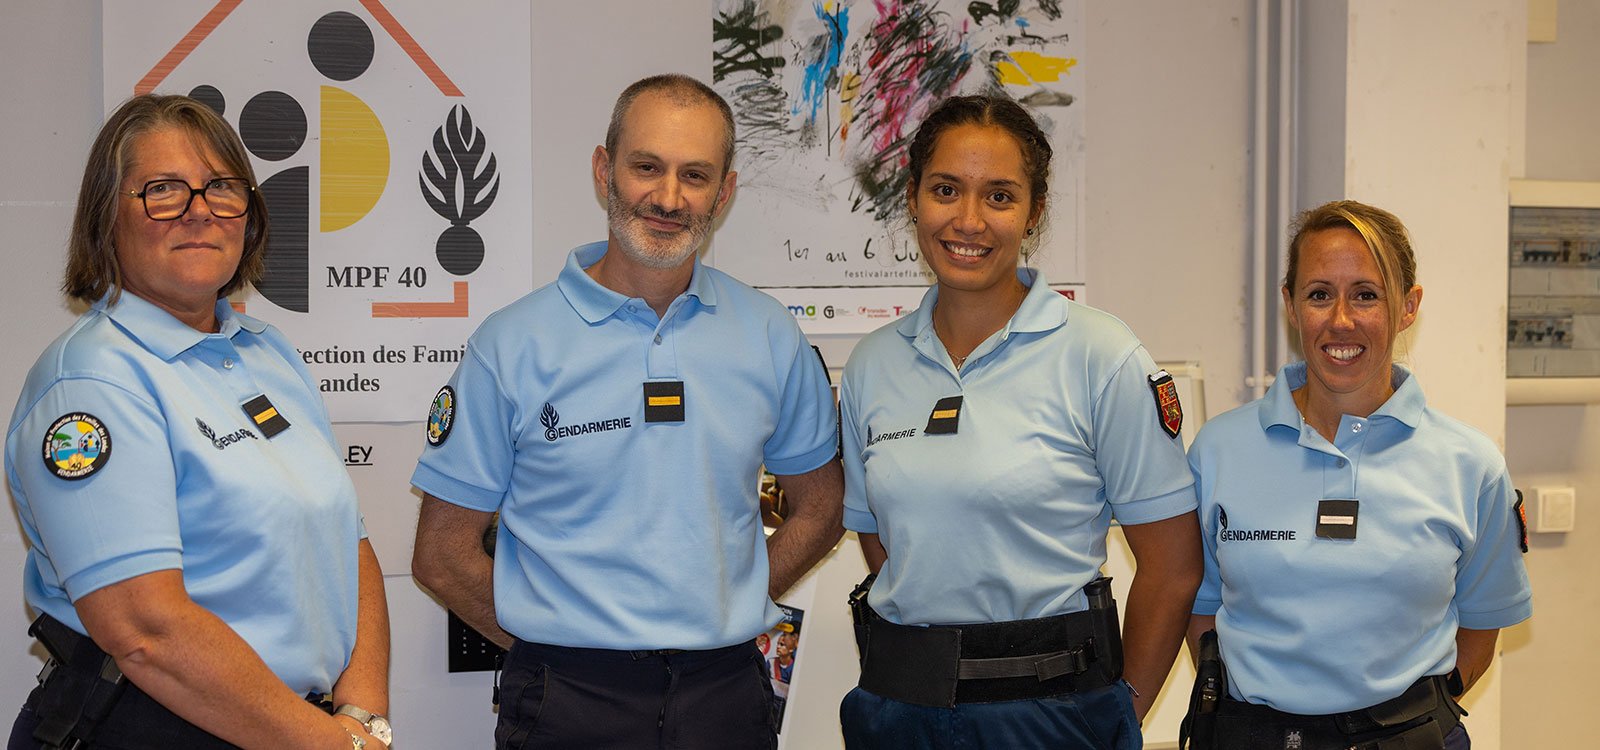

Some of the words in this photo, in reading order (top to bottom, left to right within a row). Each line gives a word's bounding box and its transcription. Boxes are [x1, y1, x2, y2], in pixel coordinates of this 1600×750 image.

[826, 252, 847, 262] au
[864, 238, 875, 259] 6
[326, 266, 389, 288] MPF
[398, 266, 427, 288] 40
[372, 344, 406, 364] des
[318, 373, 381, 392] andes
[544, 417, 632, 441] GENDARMERIE
[344, 445, 373, 463] EY
[1220, 529, 1297, 542] GENDARMERIE
